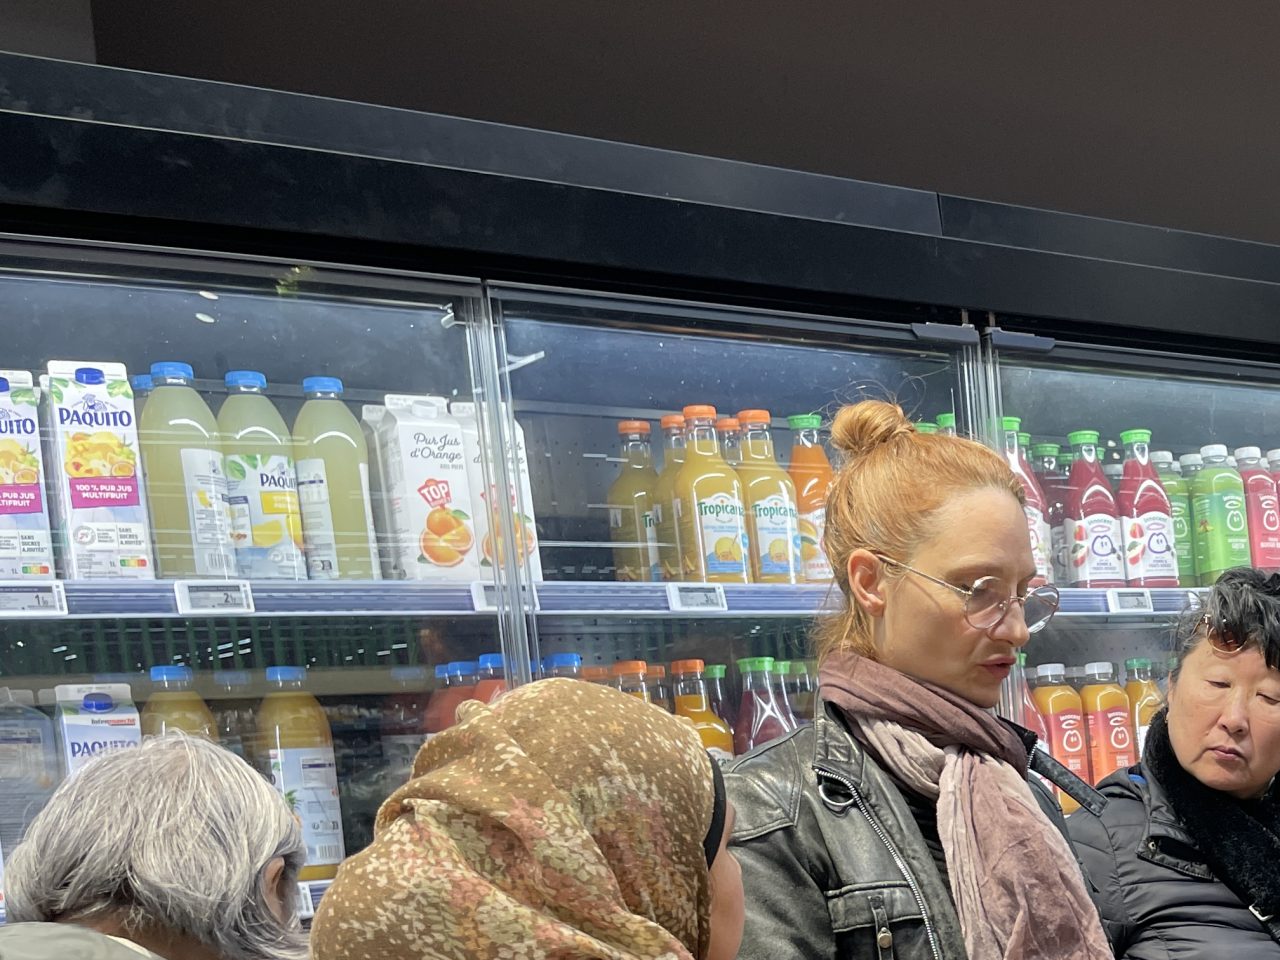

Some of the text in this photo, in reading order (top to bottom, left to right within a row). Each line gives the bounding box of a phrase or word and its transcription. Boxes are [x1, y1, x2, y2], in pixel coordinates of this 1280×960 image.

[58, 407, 132, 427] PAQUITO
[413, 432, 461, 450] Pur Jus
[410, 447, 462, 463] d'Orange
[75, 484, 90, 492] 100
[99, 484, 115, 492] PUR
[81, 491, 128, 500] MULTIFRUIT
[421, 483, 448, 502] TOP
